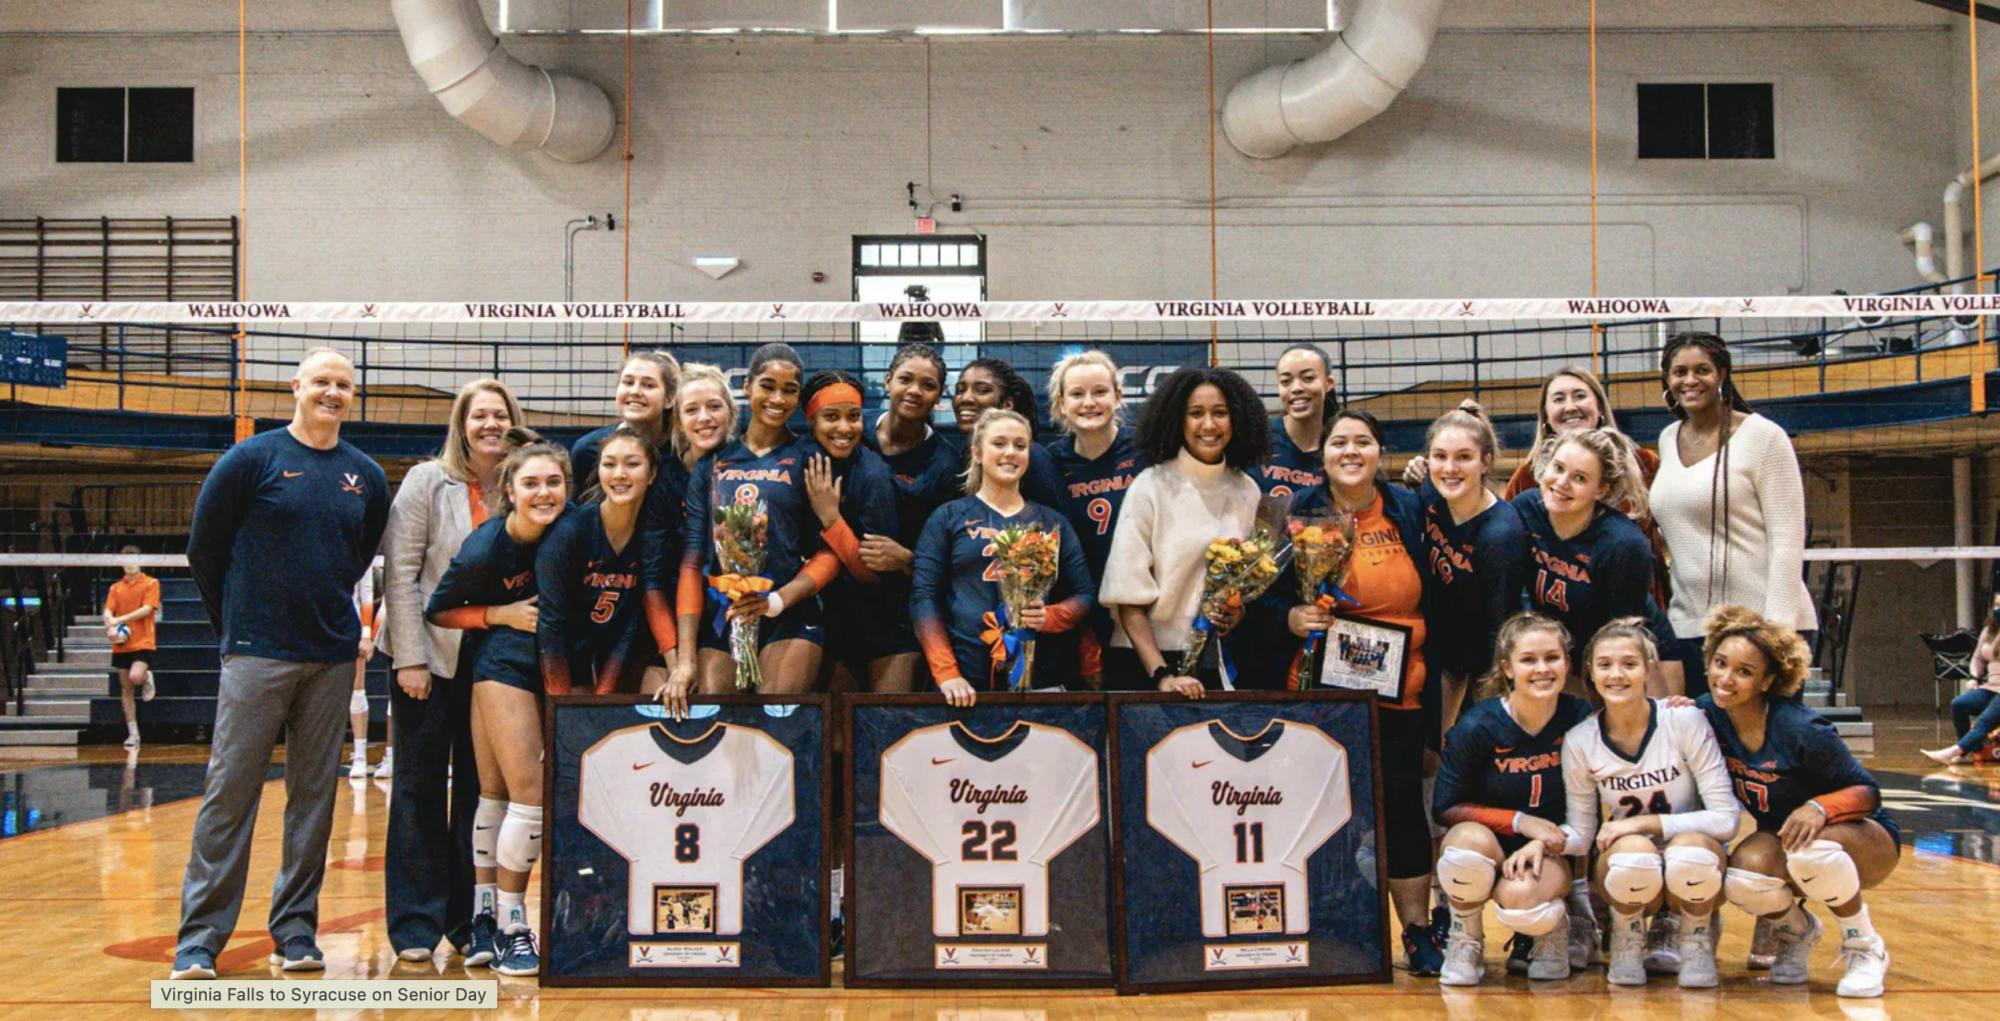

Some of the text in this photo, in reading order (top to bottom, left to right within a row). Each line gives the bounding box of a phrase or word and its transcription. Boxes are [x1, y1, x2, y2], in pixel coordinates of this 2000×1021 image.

[188, 303, 291, 318] WAHOOWA
[465, 303, 686, 318] VIRGINIA VOLLEYBALL
[878, 302, 982, 318] WAHOOWA
[1155, 301, 1375, 317] VIRGINIA VOLLEYBALL
[1567, 299, 1671, 314] WAHOOWA
[1843, 296, 2000, 312] VIRGINIA VOLLE
[1087, 497, 1112, 535] 9
[590, 591, 620, 624] 5
[1535, 568, 1570, 613] 14
[1528, 773, 1543, 808] 1
[1601, 765, 1682, 792] VIRGINIA
[1735, 777, 1770, 813] 17
[649, 781, 726, 818] Virginia
[949, 778, 1029, 815] Virginia
[1211, 780, 1284, 816] Virginia
[1618, 788, 1672, 818] 24
[674, 822, 701, 864] 8
[961, 819, 1019, 862] 22
[1232, 821, 1265, 864] 11
